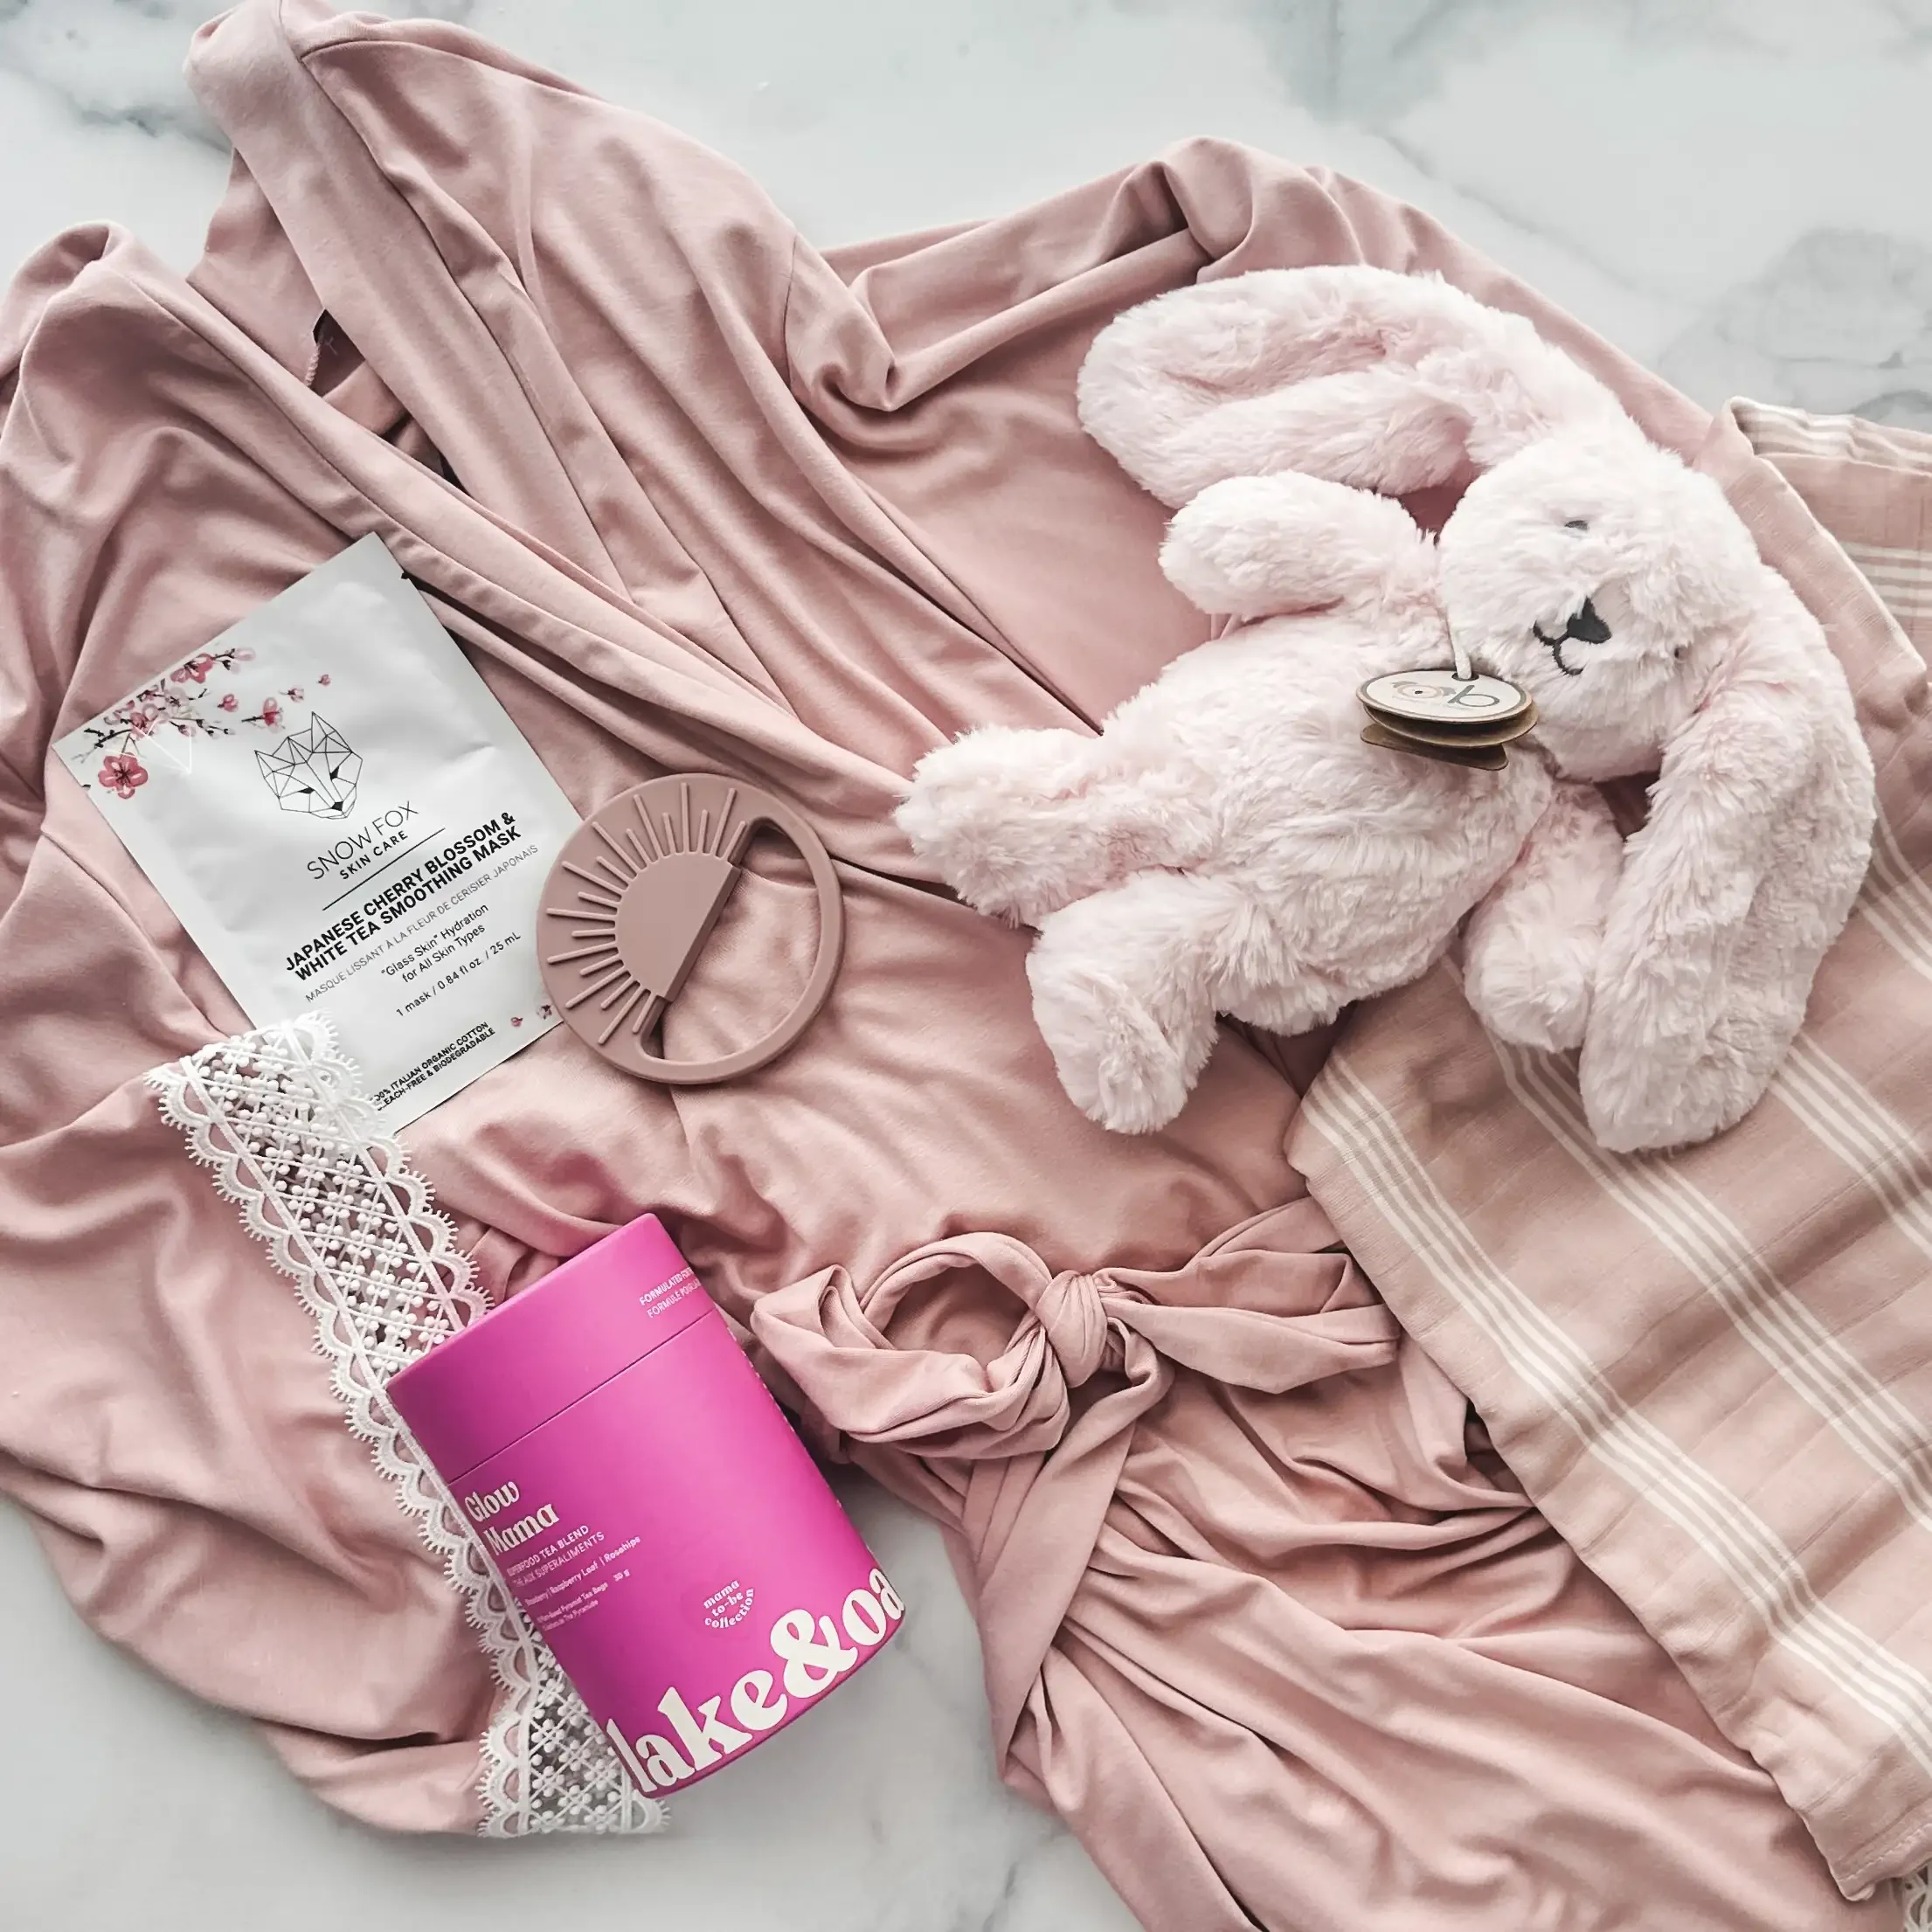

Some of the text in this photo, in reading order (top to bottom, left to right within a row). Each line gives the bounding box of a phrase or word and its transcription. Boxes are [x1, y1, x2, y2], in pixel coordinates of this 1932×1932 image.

[308, 801, 419, 879] SNOW FOX
[340, 831, 407, 879] SKIN CARE
[287, 813, 516, 970] JAPANESE CHERRY BLOSSOM &
[295, 826, 521, 980] WHITE TEA SMOOTHING MASK
[306, 972, 346, 1002] MASQUE
[347, 945, 384, 975] LISSANT
[393, 932, 408, 944] LA
[407, 911, 437, 934] FLEUR
[437, 902, 451, 914] DE
[451, 874, 491, 904] CERISIER
[494, 846, 537, 877] JAPONAIS
[440, 905, 488, 939] Hydration
[403, 925, 485, 982] for All Skin Types
[405, 993, 431, 1012] mask
[460, 966, 468, 974] fl
[490, 942, 503, 954] 25
[505, 932, 521, 945] mL
[370, 1022, 488, 1101] 00% ITALIAN ORGANIC COTTON
[377, 1074, 426, 1111] EACH-FREE
[433, 1028, 495, 1072] BIODEGRADABLE
[640, 1274, 682, 1305] FORMULATED
[465, 1482, 519, 1521] Glow
[483, 1504, 559, 1555] Mama
[539, 1545, 557, 1558] TEA
[557, 1526, 588, 1548] BLEND
[604, 1537, 641, 1562] Rosehips
[704, 1581, 739, 1609] mama
[704, 1587, 755, 1628] collection
[712, 1593, 743, 1617] to-be
